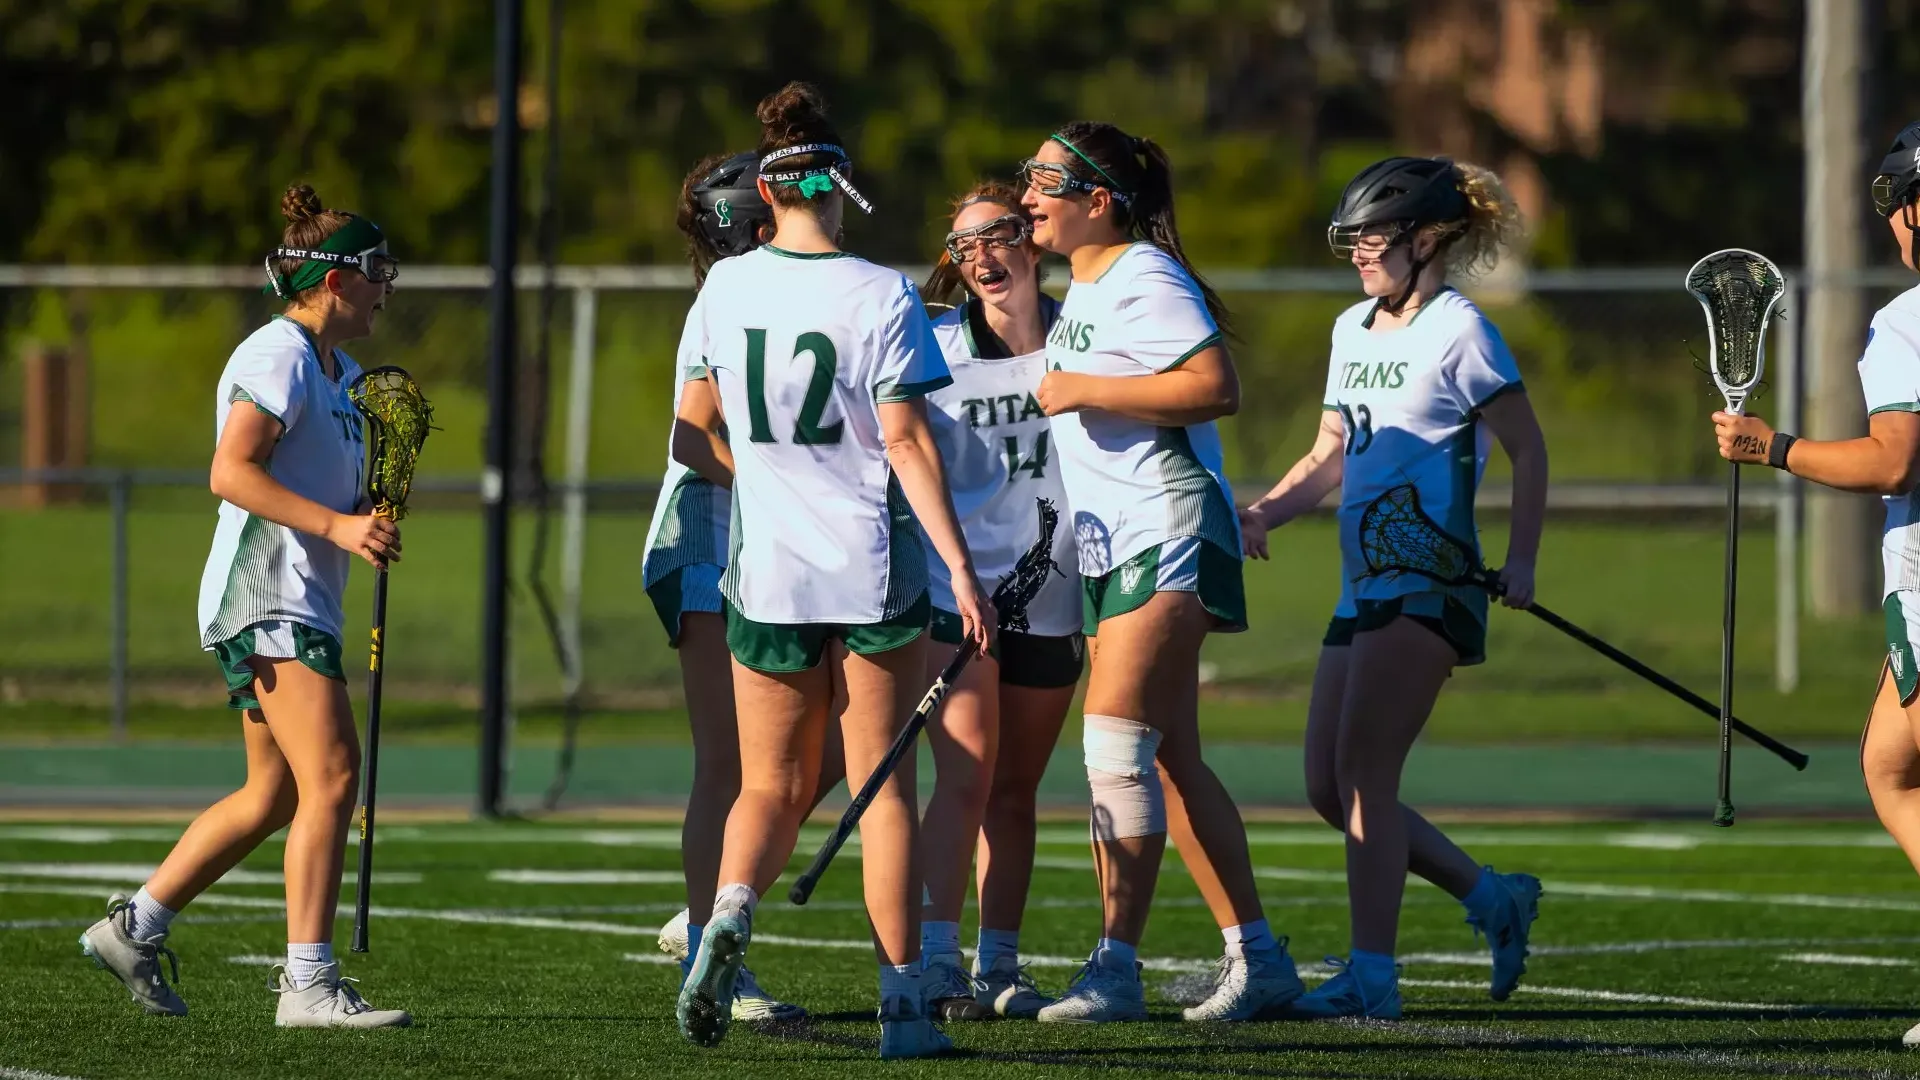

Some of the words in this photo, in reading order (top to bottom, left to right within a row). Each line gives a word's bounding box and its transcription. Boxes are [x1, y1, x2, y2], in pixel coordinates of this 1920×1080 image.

[776, 172, 800, 181] GAIT
[286, 249, 307, 258] GAIT
[311, 251, 339, 262] GAIT
[743, 328, 844, 445] 12
[1338, 402, 1374, 456] 13
[1001, 428, 1050, 483] 14
[916, 675, 949, 720] STX
